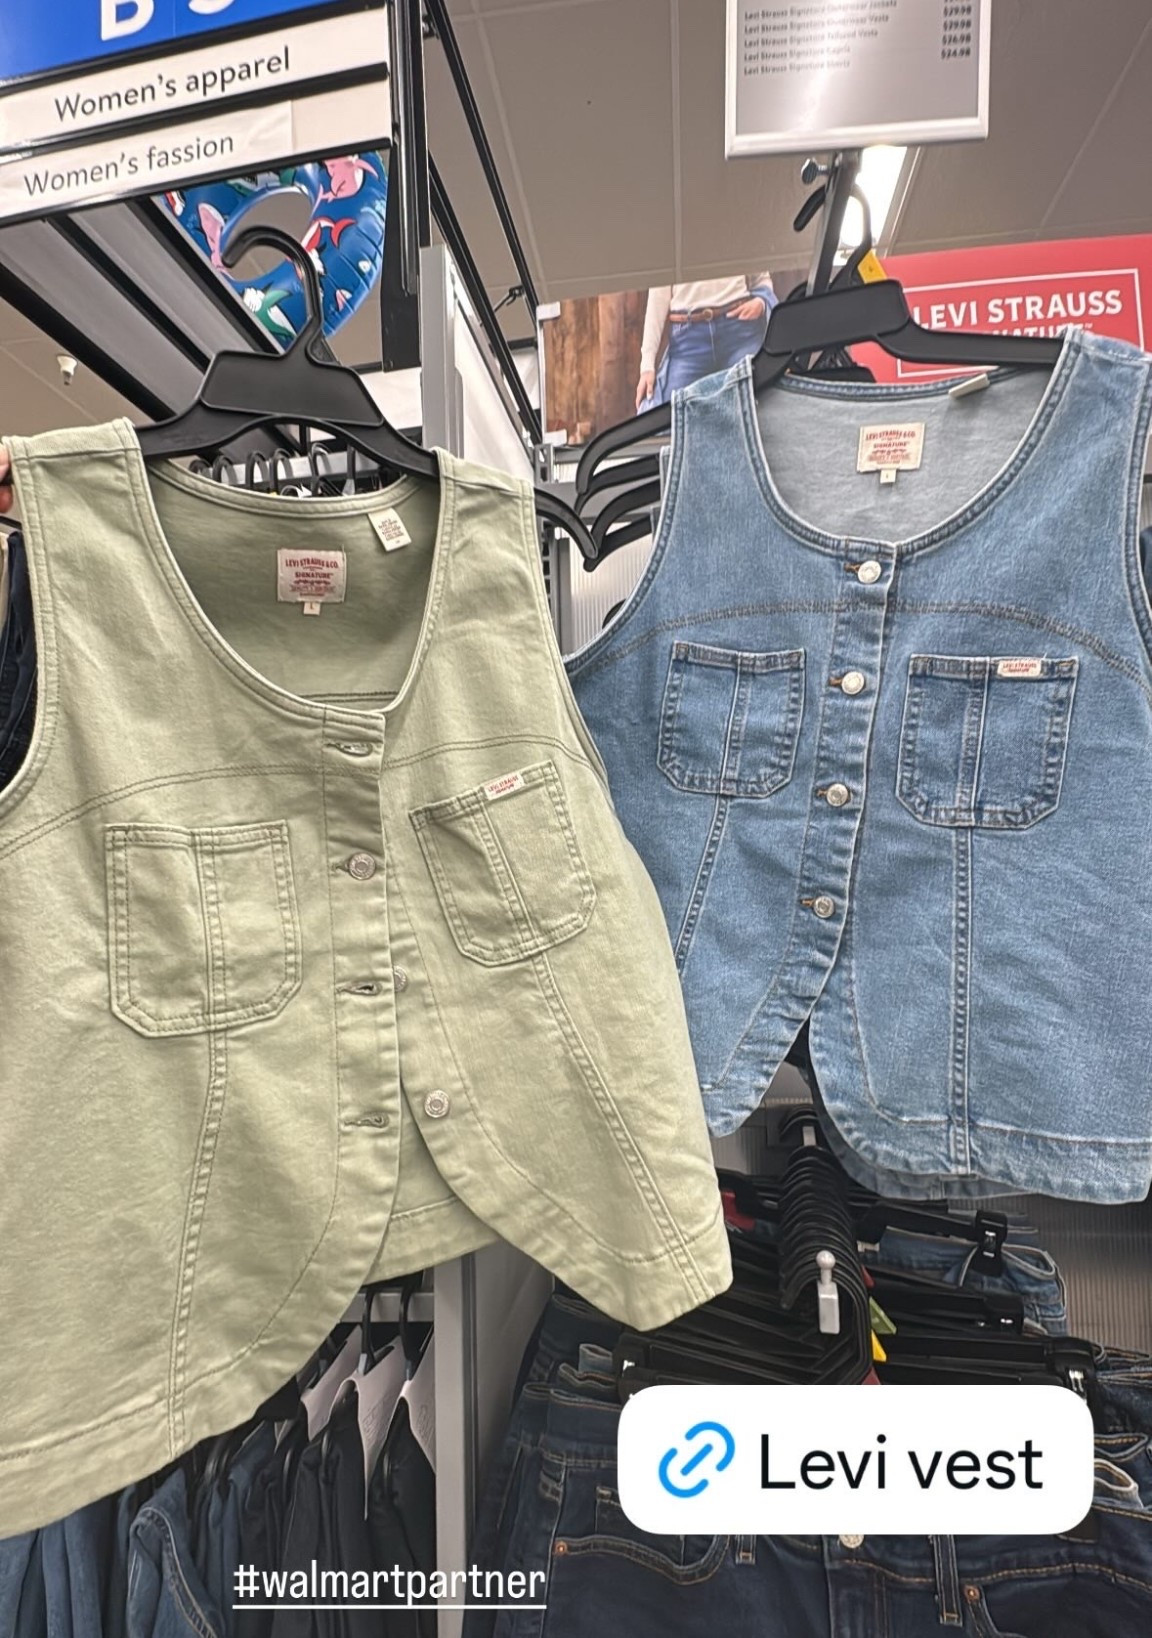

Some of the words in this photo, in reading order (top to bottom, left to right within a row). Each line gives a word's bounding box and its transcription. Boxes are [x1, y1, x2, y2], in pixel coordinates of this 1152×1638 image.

[185, 45, 290, 97] apparel
[148, 135, 234, 170] fassion
[913, 300, 978, 330] LEVI
[987, 289, 1123, 324] STRAUSS
[285, 559, 299, 568] LEVI
